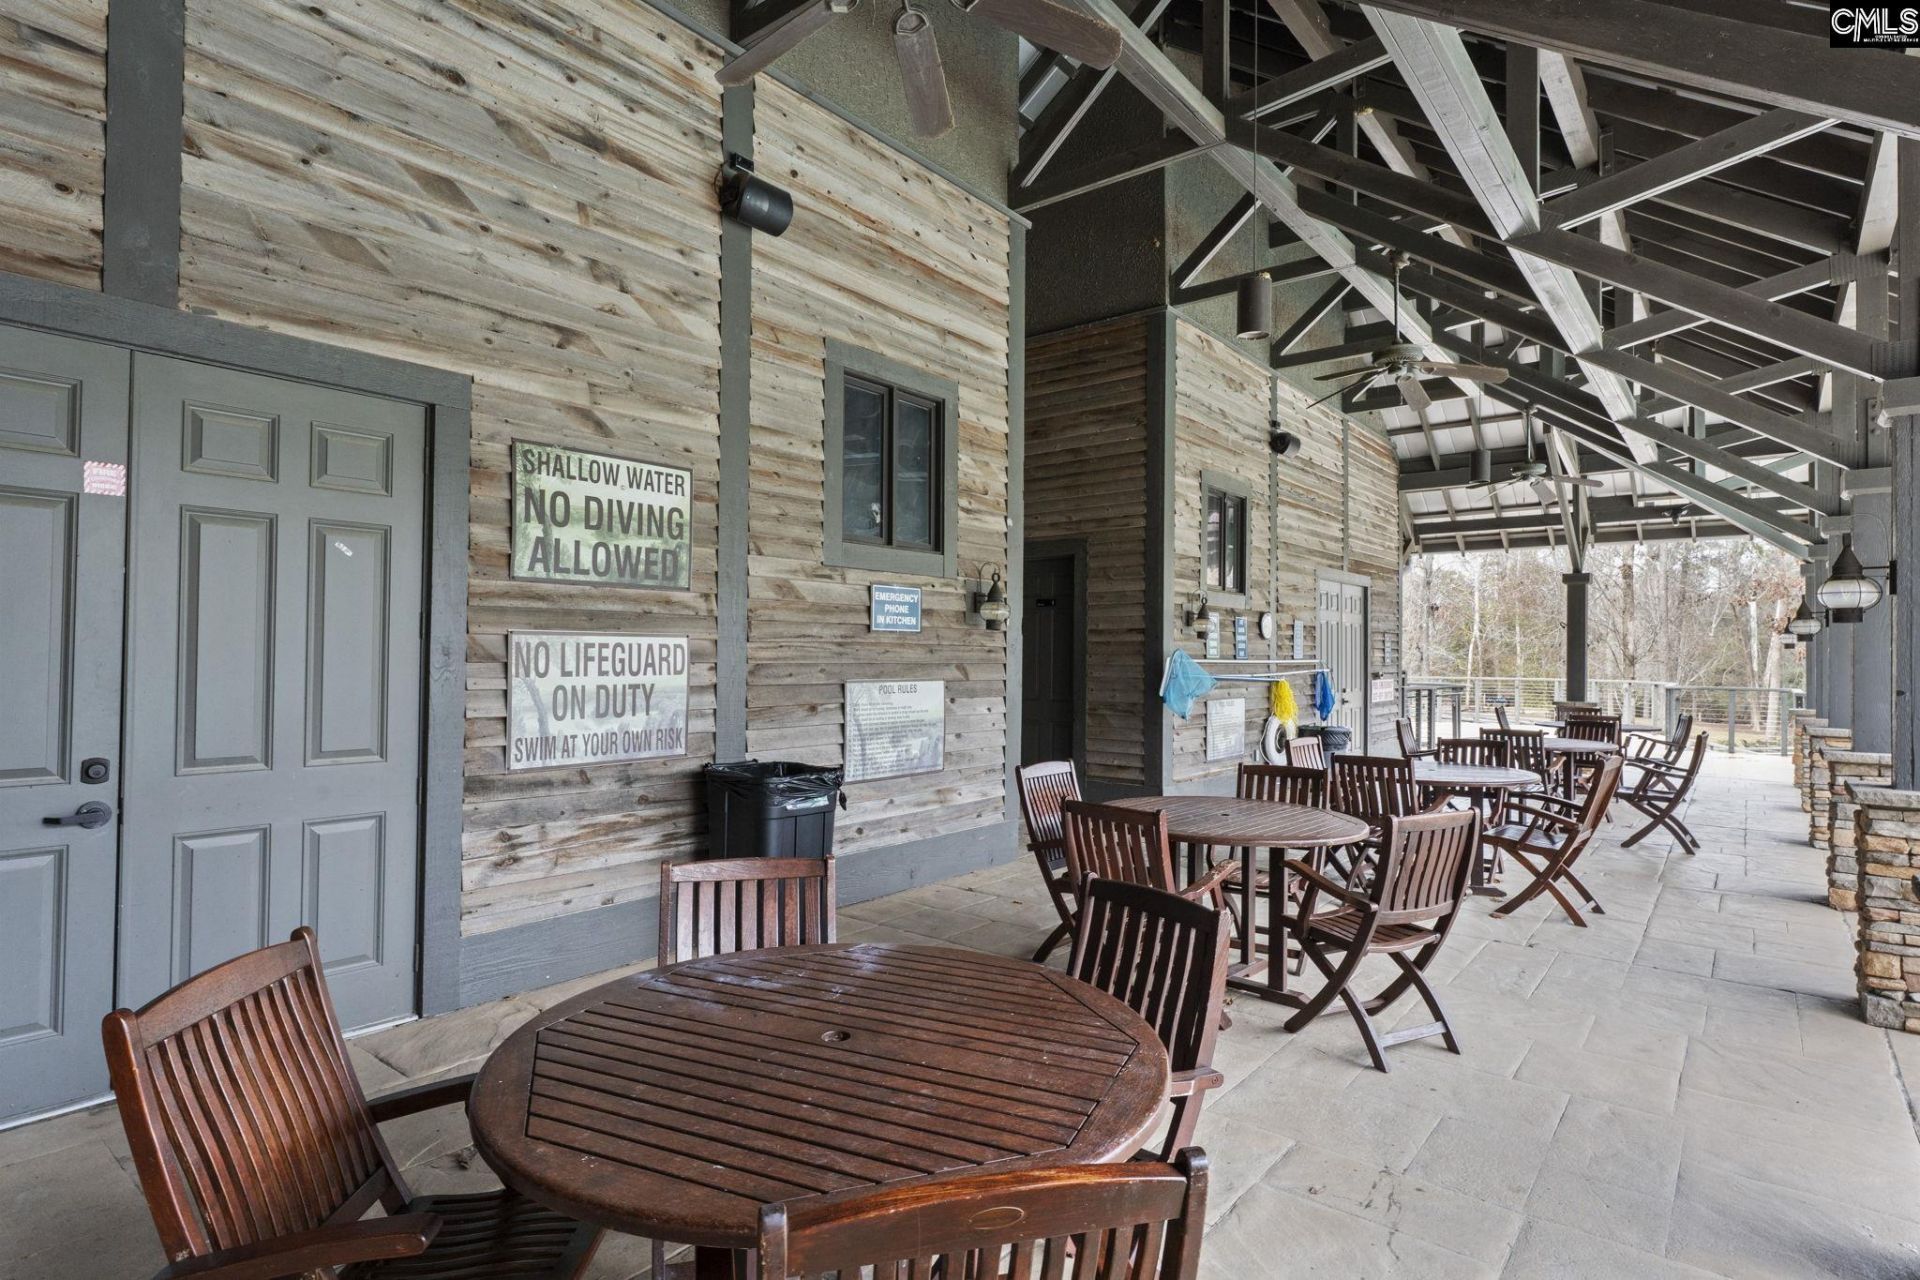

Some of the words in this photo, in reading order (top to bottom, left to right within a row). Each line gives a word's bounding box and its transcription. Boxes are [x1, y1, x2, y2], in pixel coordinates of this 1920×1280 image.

[522, 449, 620, 486] SHALLOW
[627, 466, 685, 496] WATER
[524, 487, 570, 528] NO
[584, 495, 685, 540] DIVING
[528, 536, 679, 581] ALLOWED
[875, 592, 918, 603] EMERGENCY
[885, 604, 909, 613] PHONE
[876, 615, 885, 624] IN
[886, 615, 916, 625] KITCHEN
[515, 641, 550, 678] NO
[560, 642, 685, 677] LIFEGUARD
[552, 685, 585, 721] ON
[595, 683, 655, 718] DUTY
[879, 684, 896, 695] POOL
[898, 684, 918, 694] RULES
[515, 736, 556, 763] SWIM
[561, 735, 578, 758] AT
[583, 731, 618, 756] YOUR
[623, 730, 652, 754] OWN
[656, 727, 683, 750] RISK
